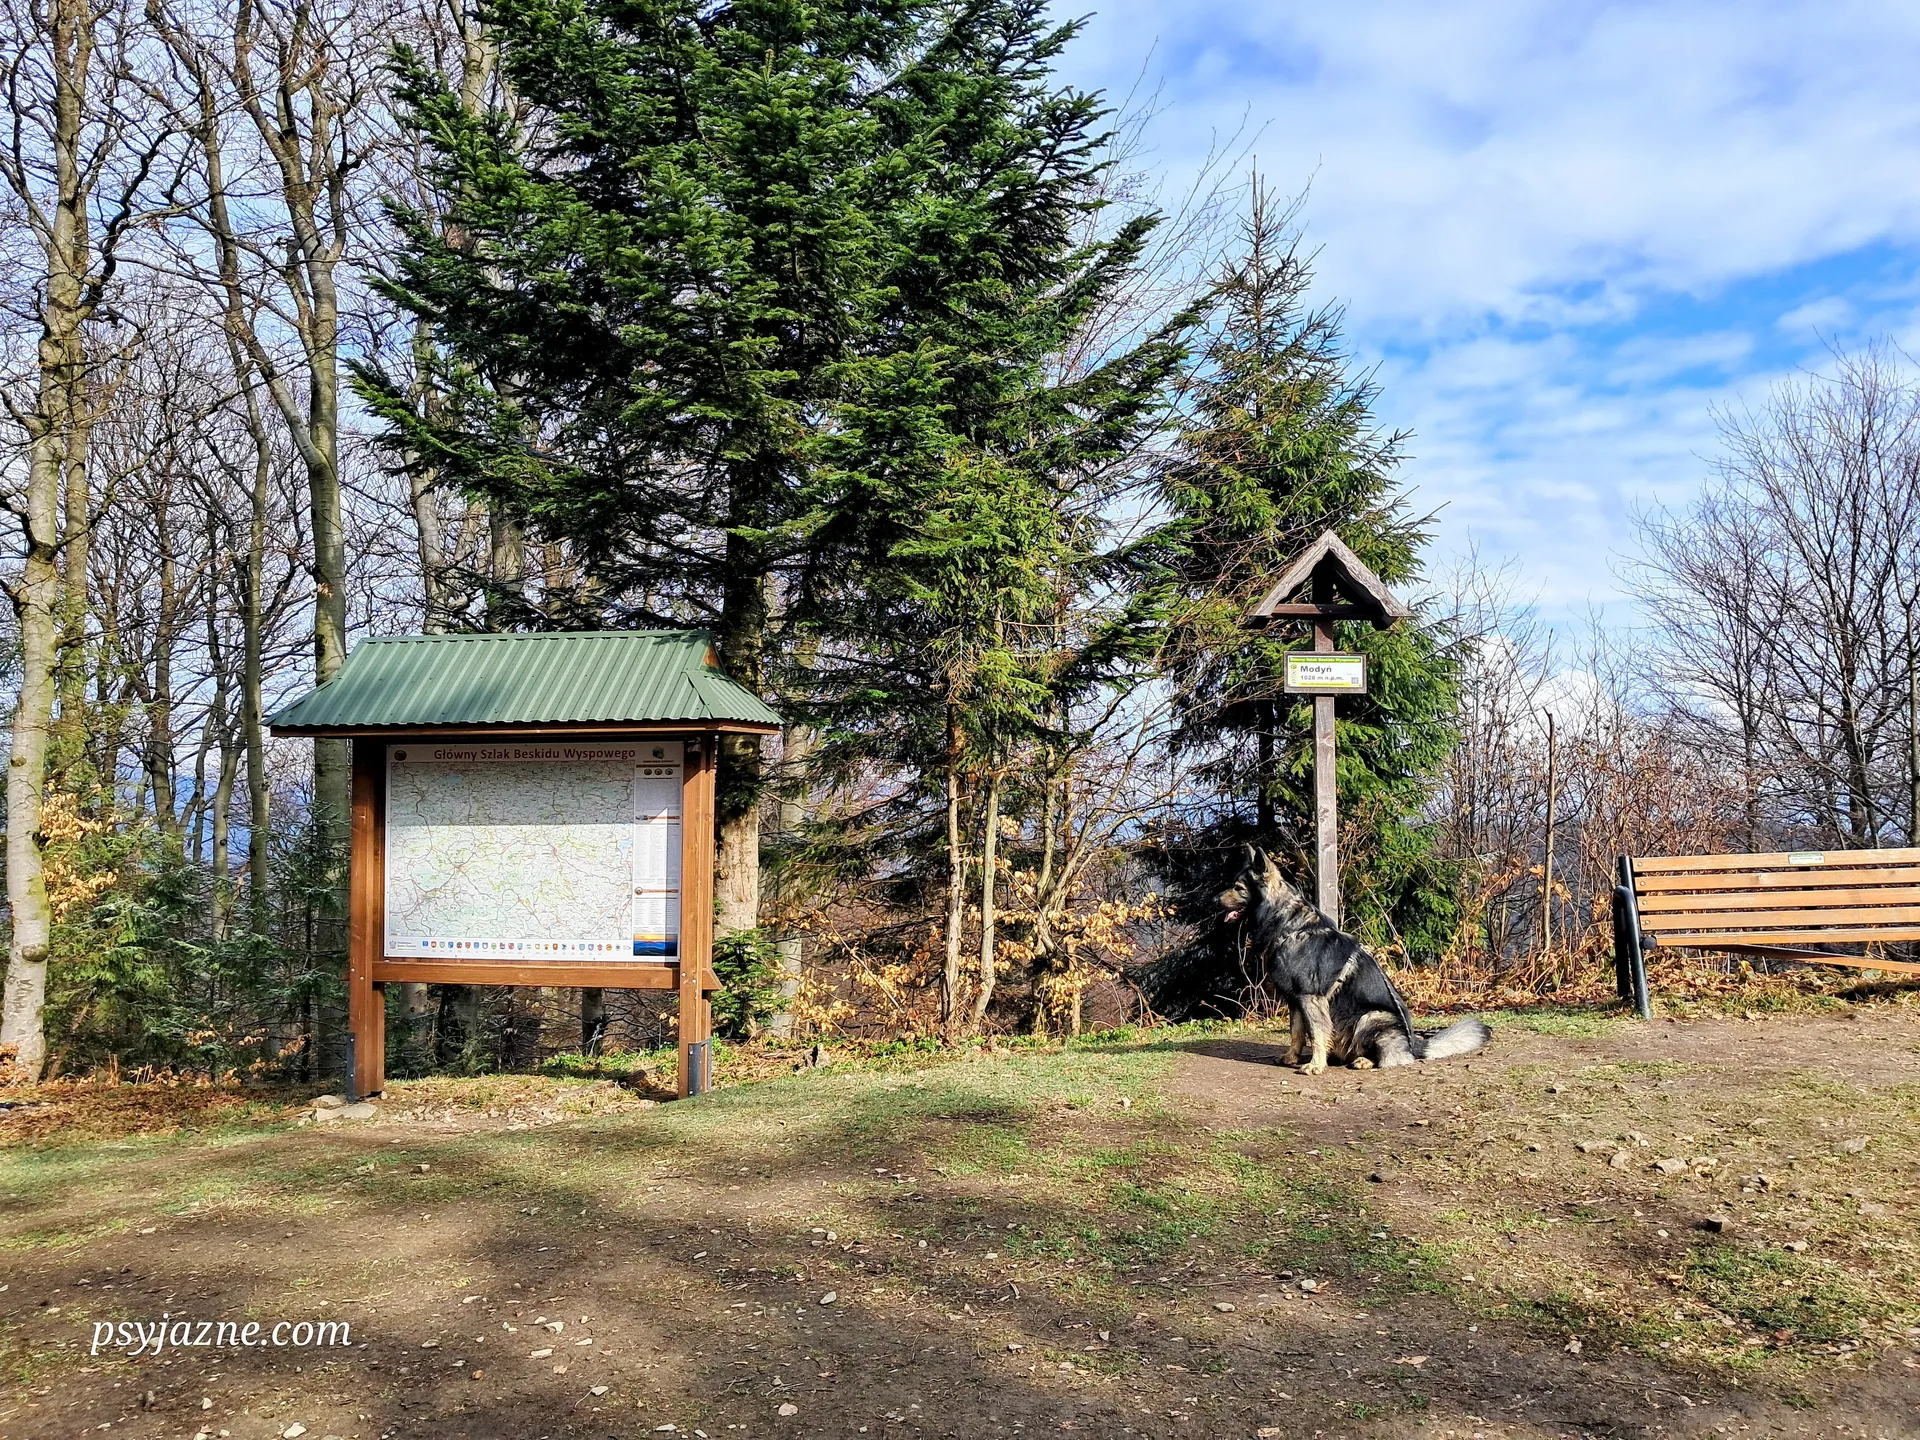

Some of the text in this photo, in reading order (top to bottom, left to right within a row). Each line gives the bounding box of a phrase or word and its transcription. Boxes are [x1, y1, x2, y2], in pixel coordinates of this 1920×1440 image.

[1300, 665, 1332, 674] Modyń
[434, 748, 635, 761] Główny Szlak Beskidu Wyspowego
